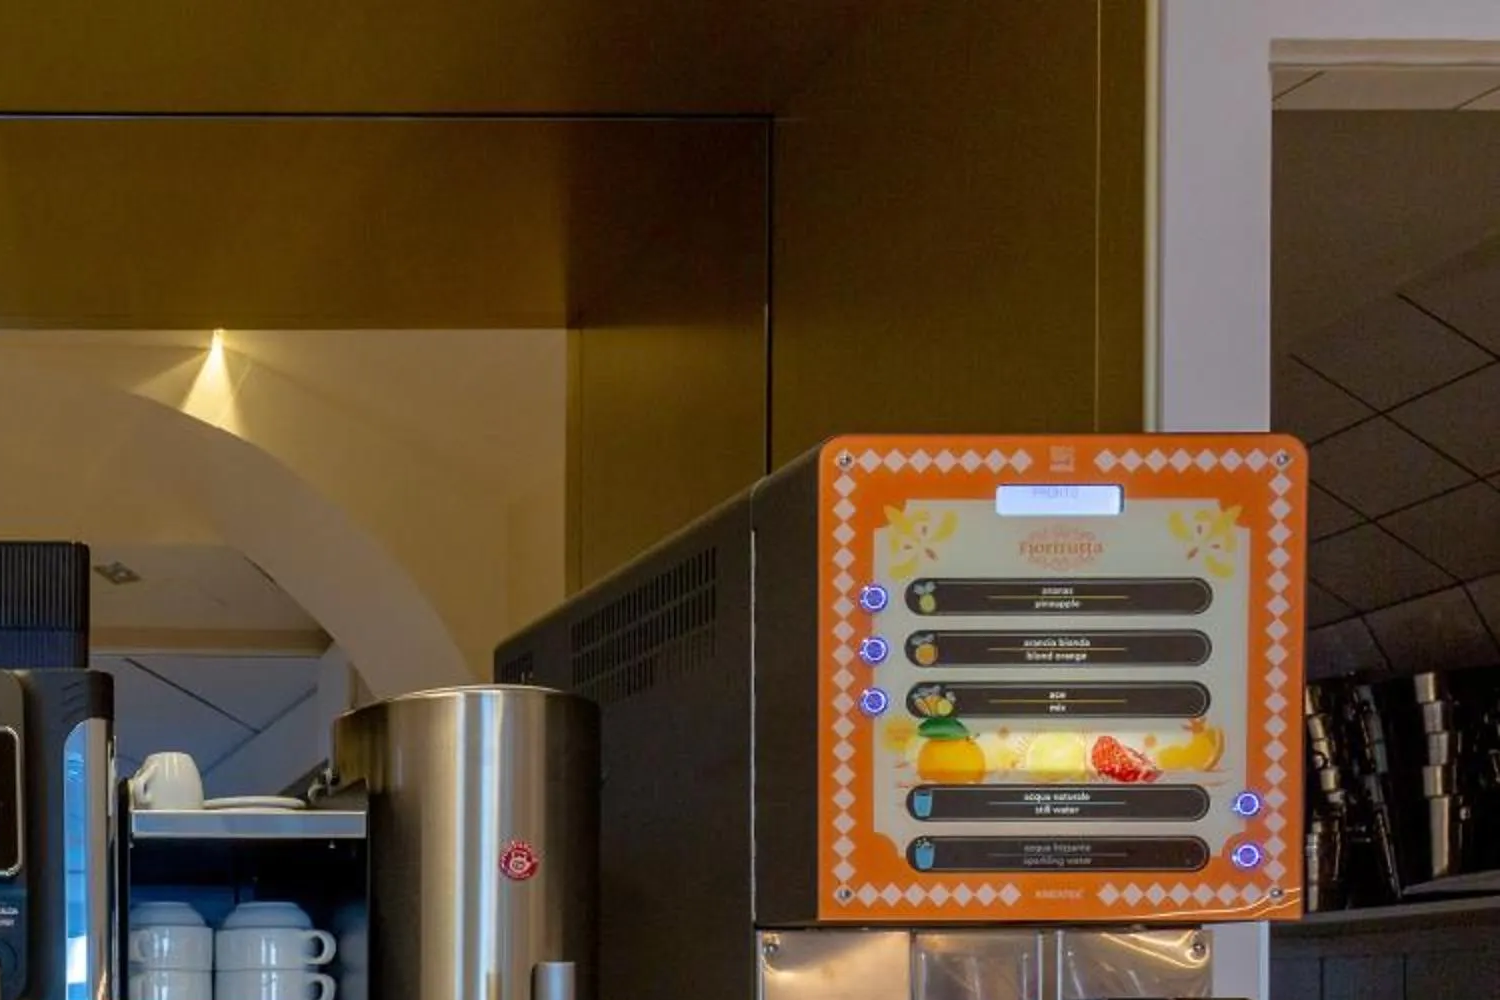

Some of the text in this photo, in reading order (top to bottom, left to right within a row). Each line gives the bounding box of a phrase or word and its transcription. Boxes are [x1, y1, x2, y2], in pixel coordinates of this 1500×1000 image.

[1034, 597, 1081, 609] pineapple
[1055, 653, 1087, 662] orange
[1049, 703, 1066, 712] mix
[1023, 791, 1091, 804] acqua naturale
[1035, 805, 1080, 814] still water
[1066, 857, 1093, 865] water
